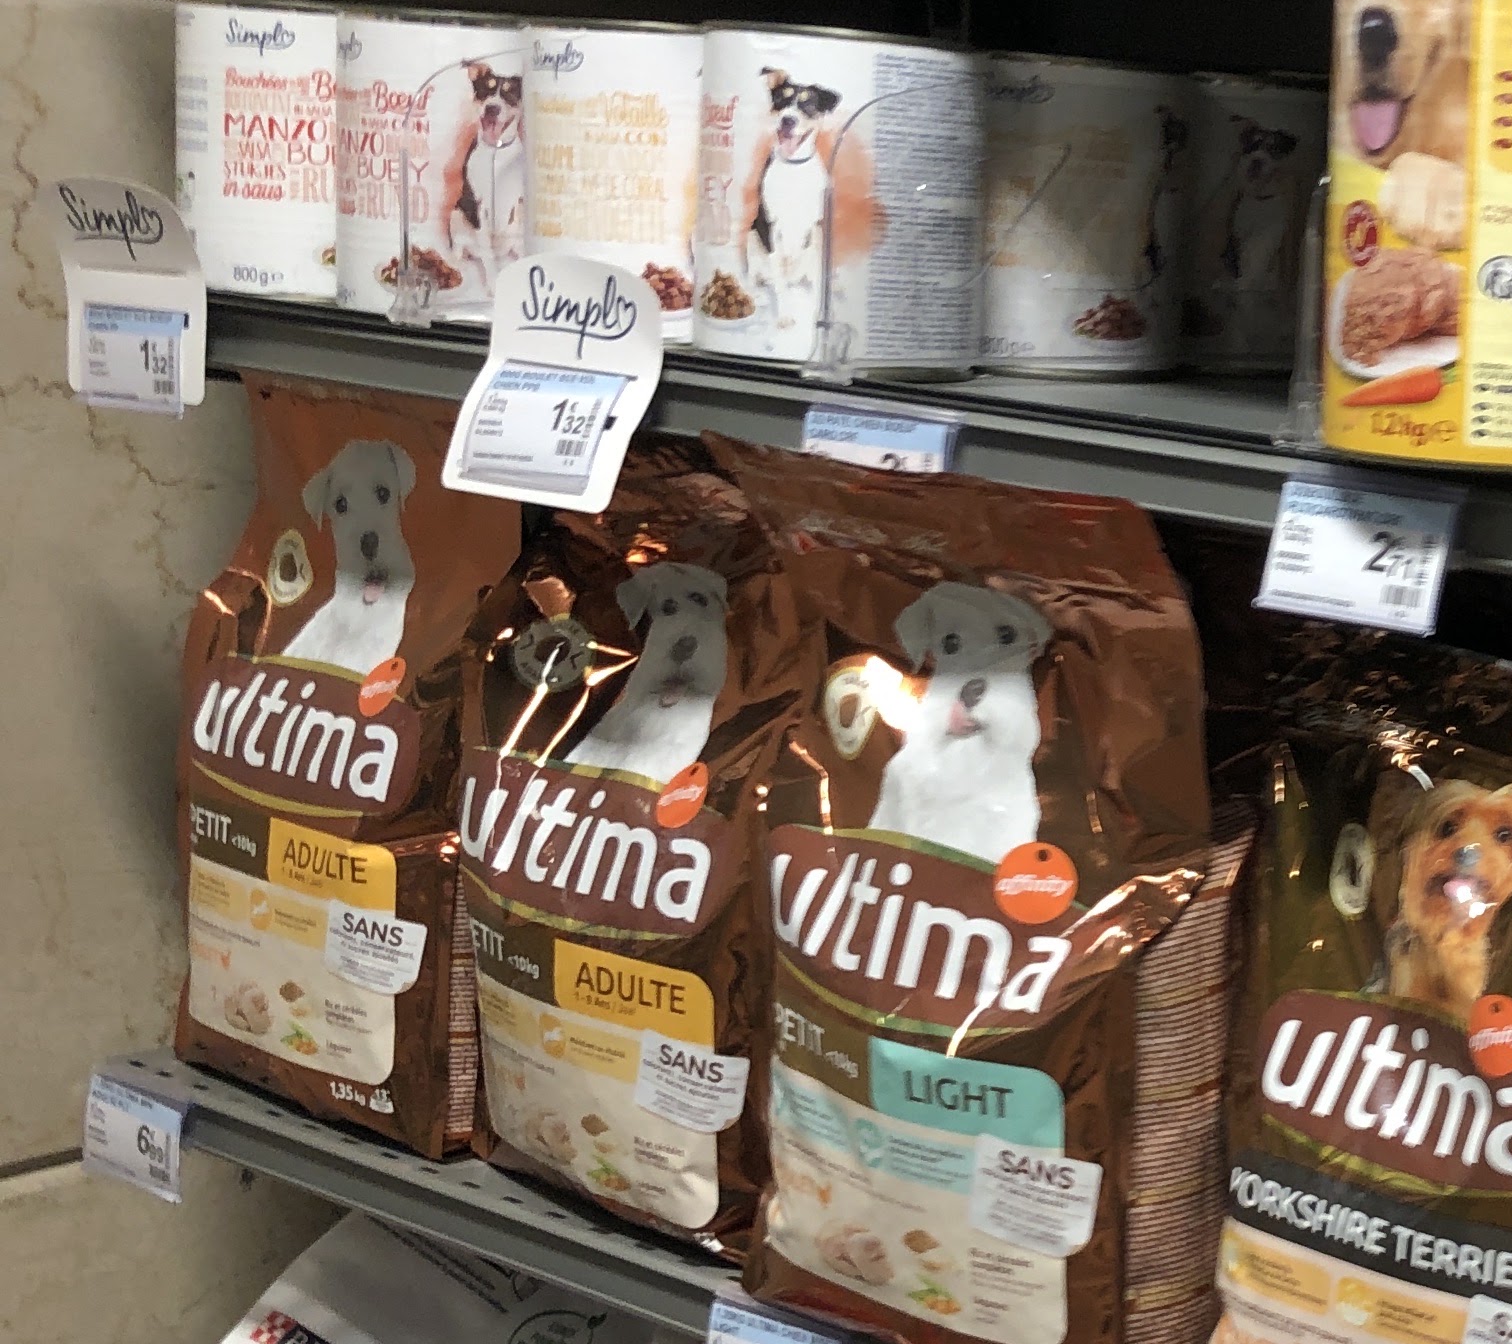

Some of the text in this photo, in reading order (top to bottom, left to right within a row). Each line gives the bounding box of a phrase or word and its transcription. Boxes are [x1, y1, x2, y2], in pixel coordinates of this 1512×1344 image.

[224, 112, 330, 142] MANZO
[340, 130, 385, 154] ANZO
[551, 398, 585, 434] 1€32
[194, 672, 401, 803] ultima
[283, 837, 369, 885] ADULTE
[460, 770, 712, 925] ultima
[341, 911, 405, 948] SANS
[471, 924, 507, 964] ETIT
[769, 851, 1074, 1016] ultima
[574, 960, 688, 1016] ADULTE
[659, 1042, 725, 1085] SANS
[902, 1068, 1014, 1121] LIGHT
[997, 1147, 1078, 1192] SANS
[1229, 1166, 1389, 1256] YORKSHIRE
